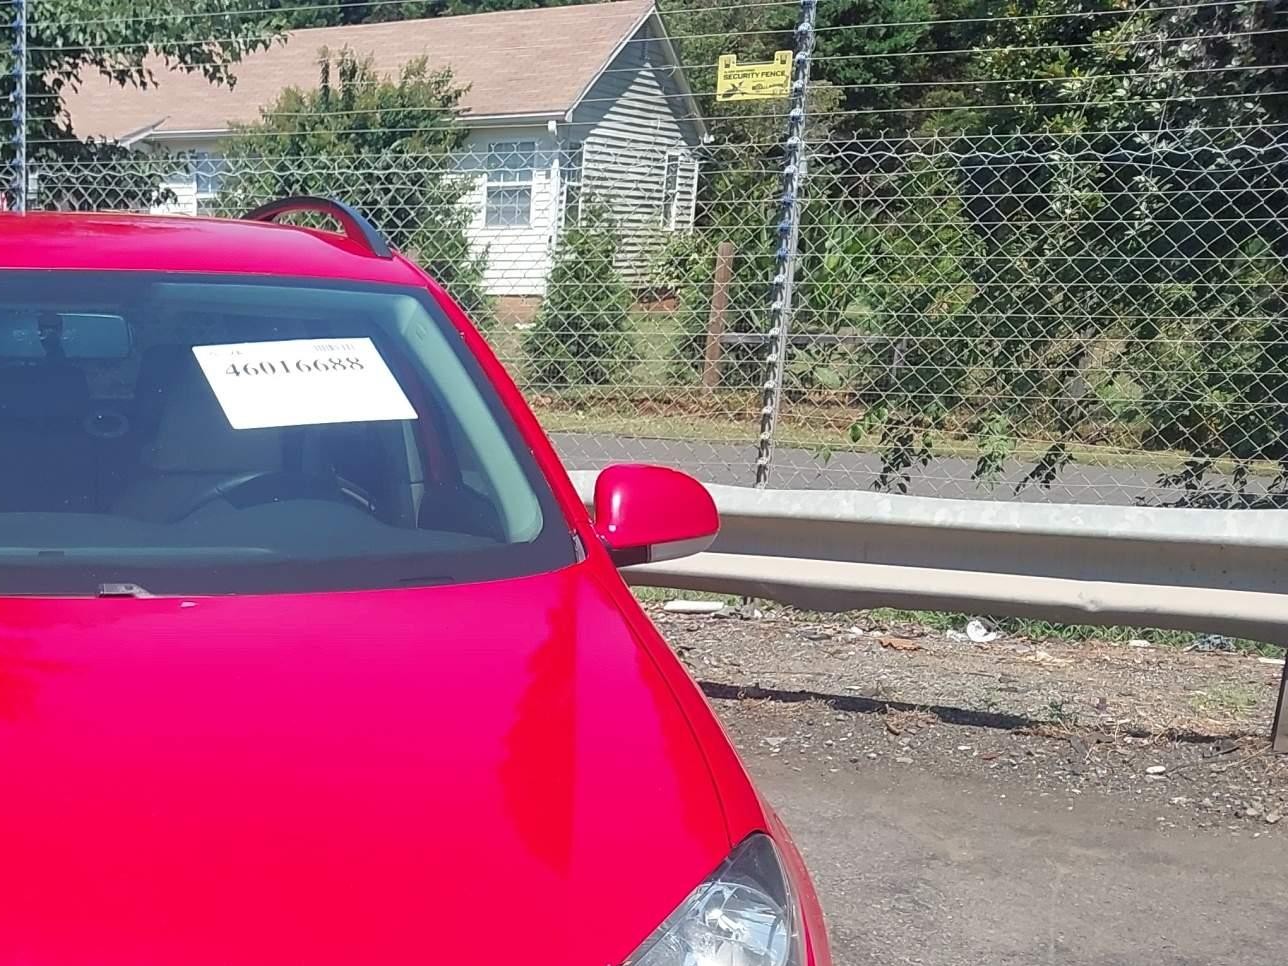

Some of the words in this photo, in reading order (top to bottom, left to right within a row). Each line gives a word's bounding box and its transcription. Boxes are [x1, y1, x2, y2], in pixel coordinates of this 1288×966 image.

[723, 72, 760, 80] SECURITY
[761, 70, 786, 78] FENCE
[225, 356, 365, 377] 46016688
